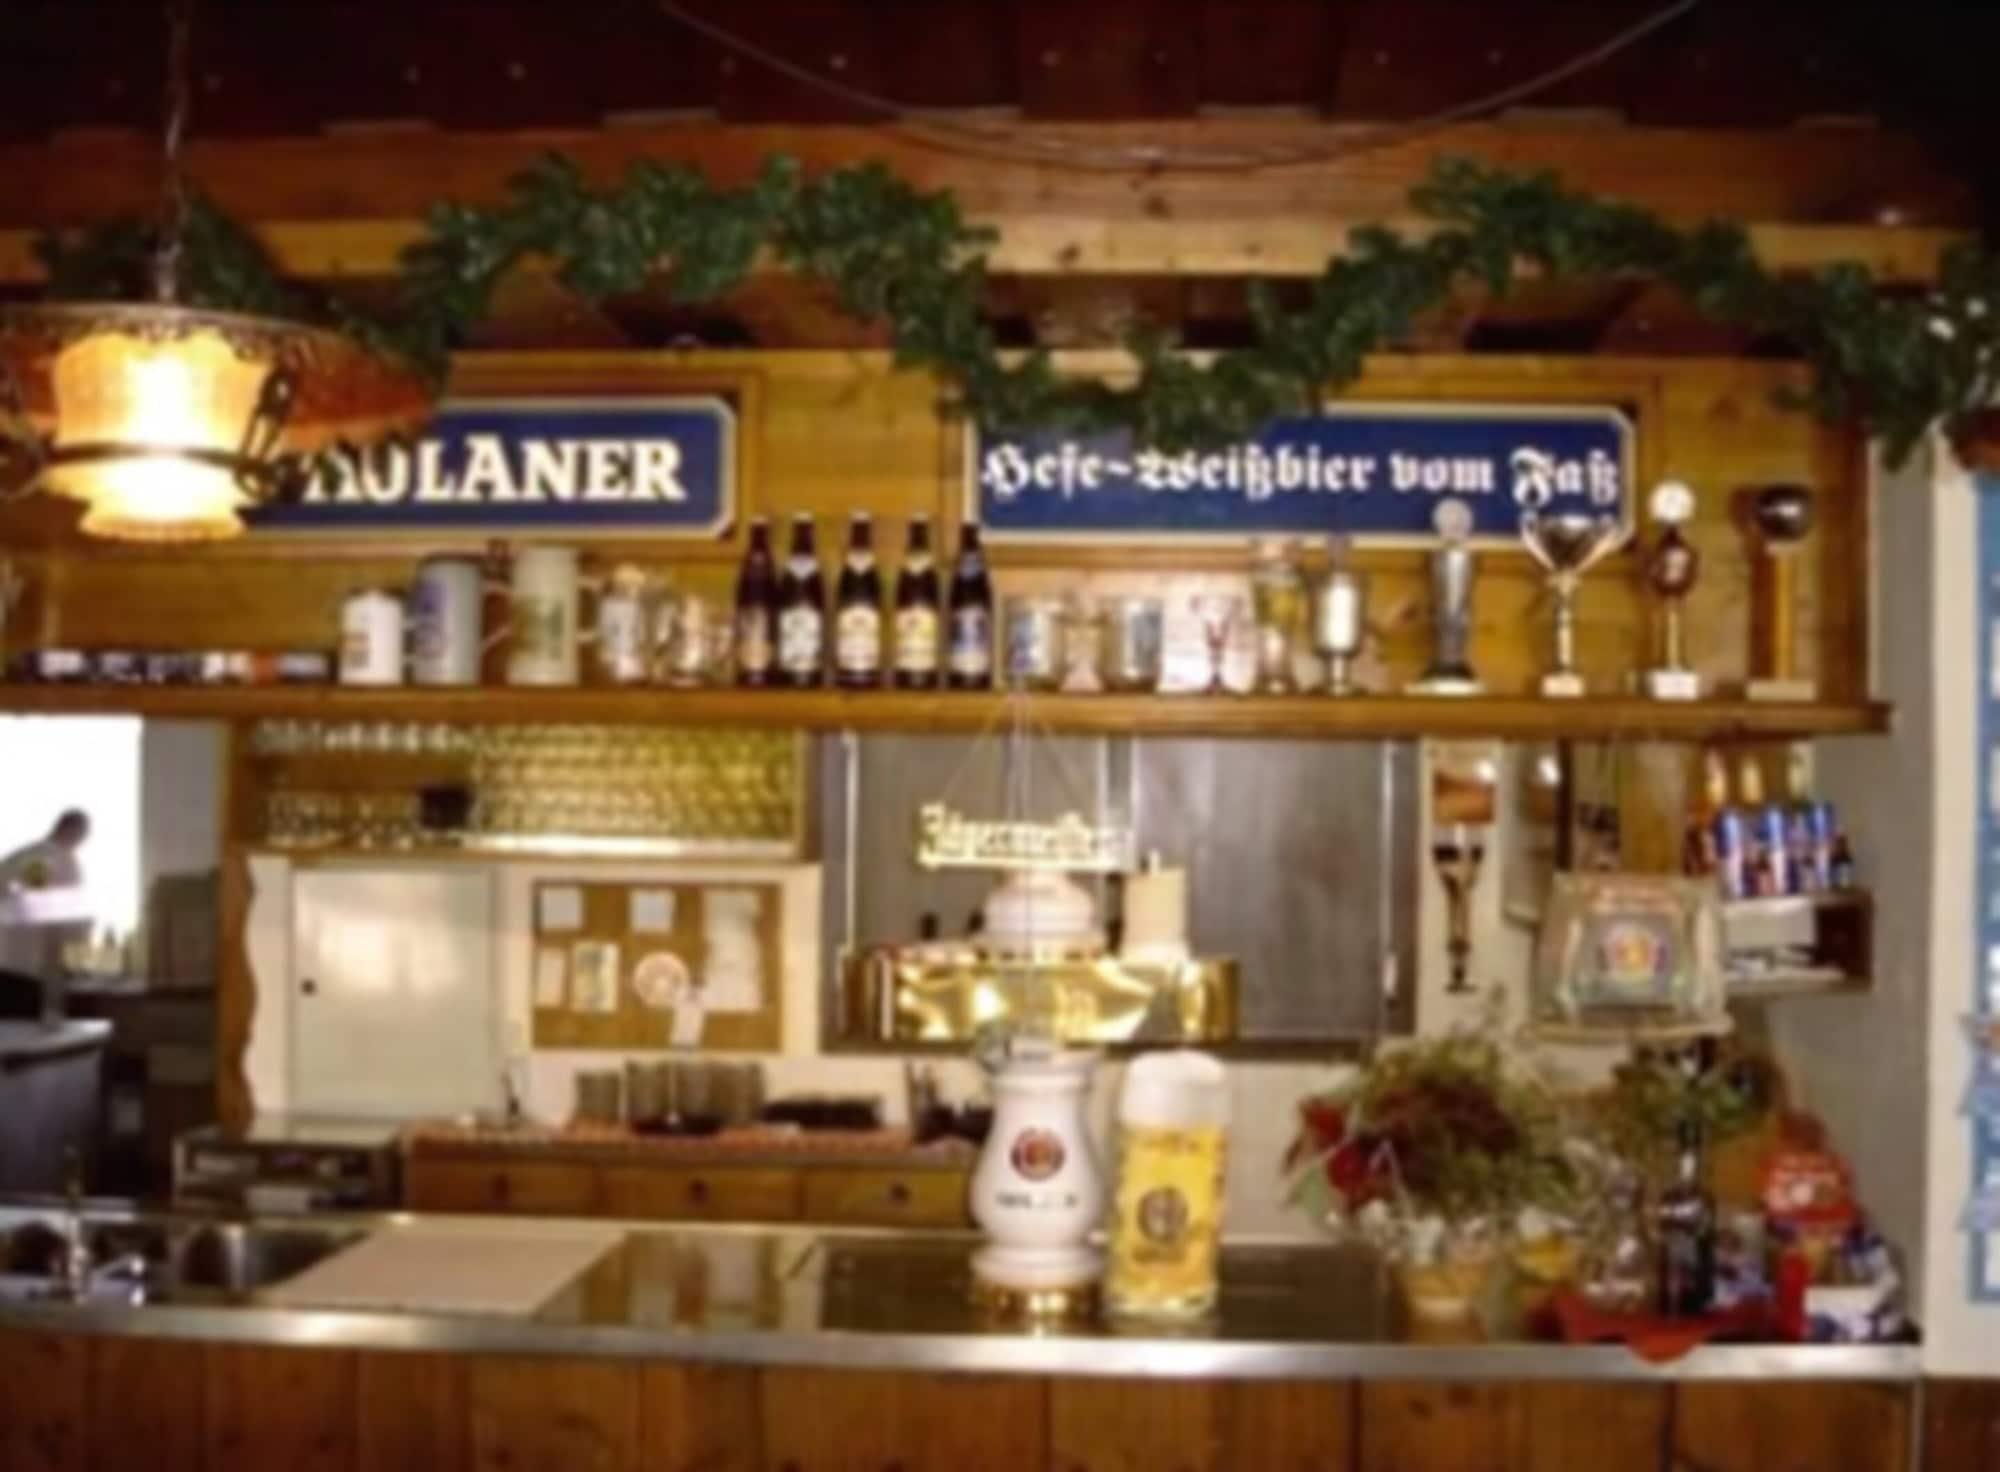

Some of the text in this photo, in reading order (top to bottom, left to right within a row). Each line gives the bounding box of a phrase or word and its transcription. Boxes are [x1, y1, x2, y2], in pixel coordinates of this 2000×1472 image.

[301, 433, 686, 503] AULANER
[981, 441, 1376, 502] Hefe-Weißbier
[1389, 449, 1494, 493] vom
